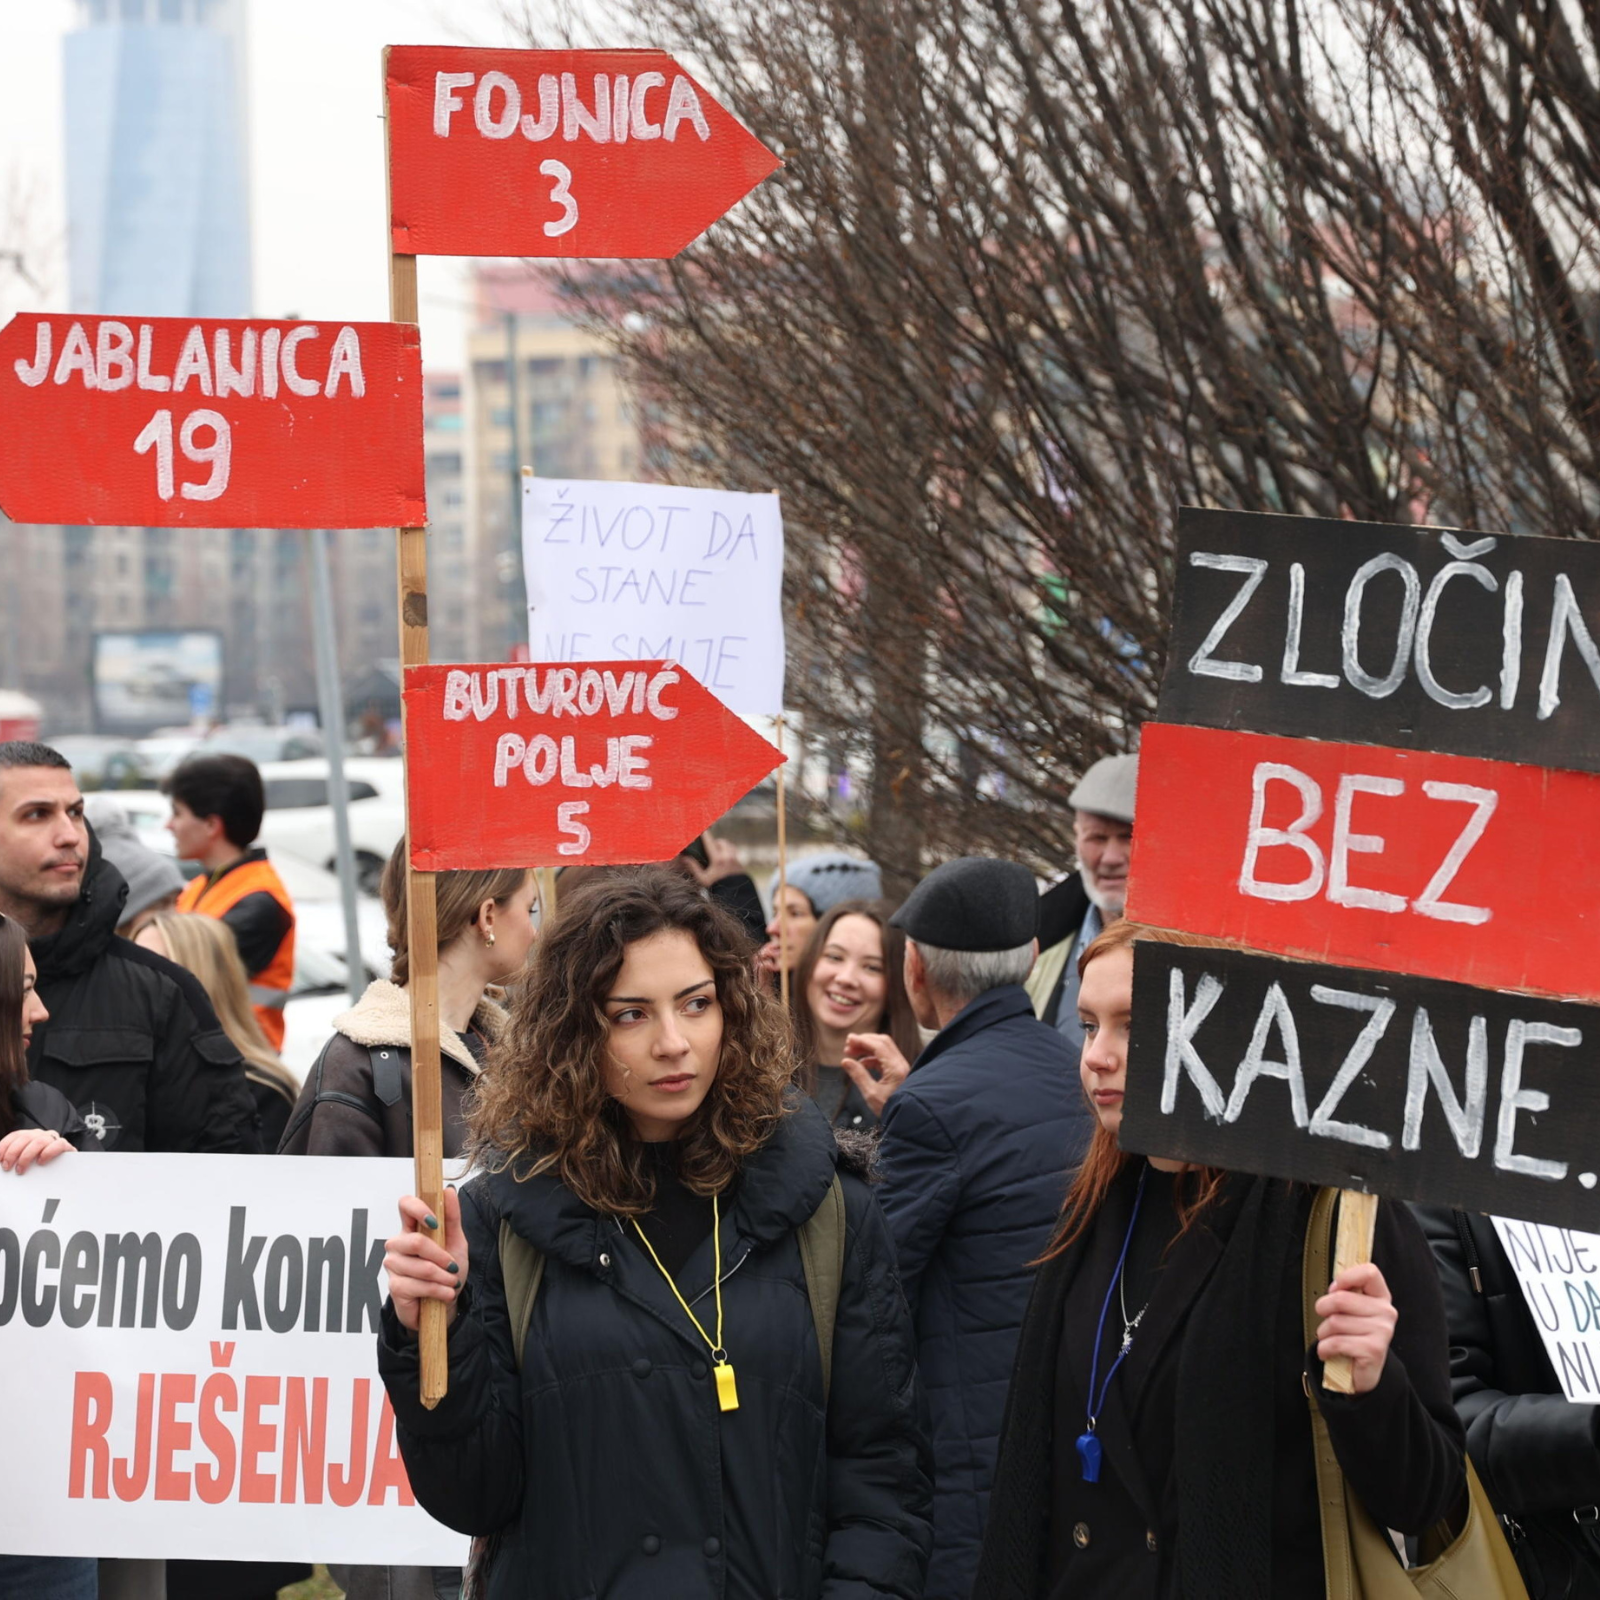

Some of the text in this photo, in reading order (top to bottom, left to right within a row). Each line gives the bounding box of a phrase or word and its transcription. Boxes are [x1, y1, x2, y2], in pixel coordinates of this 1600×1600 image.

[433, 70, 711, 143] FOJNICA
[539, 158, 579, 238] 3
[13, 320, 366, 399] JABLANICA
[133, 408, 232, 502] 19
[543, 487, 759, 561] ŽIVOT DA
[570, 566, 713, 607] STANE
[442, 659, 681, 722] BUTUROVIĆ
[493, 732, 654, 790] POLJE
[556, 800, 591, 856] 5
[1238, 761, 1499, 926] BEZ
[1160, 966, 1598, 1189] KAZNE.
[1503, 1222, 1597, 1275] NIJE
[1526, 1280, 1560, 1332] U
[68, 1341, 415, 1507] RJEŠENJA
